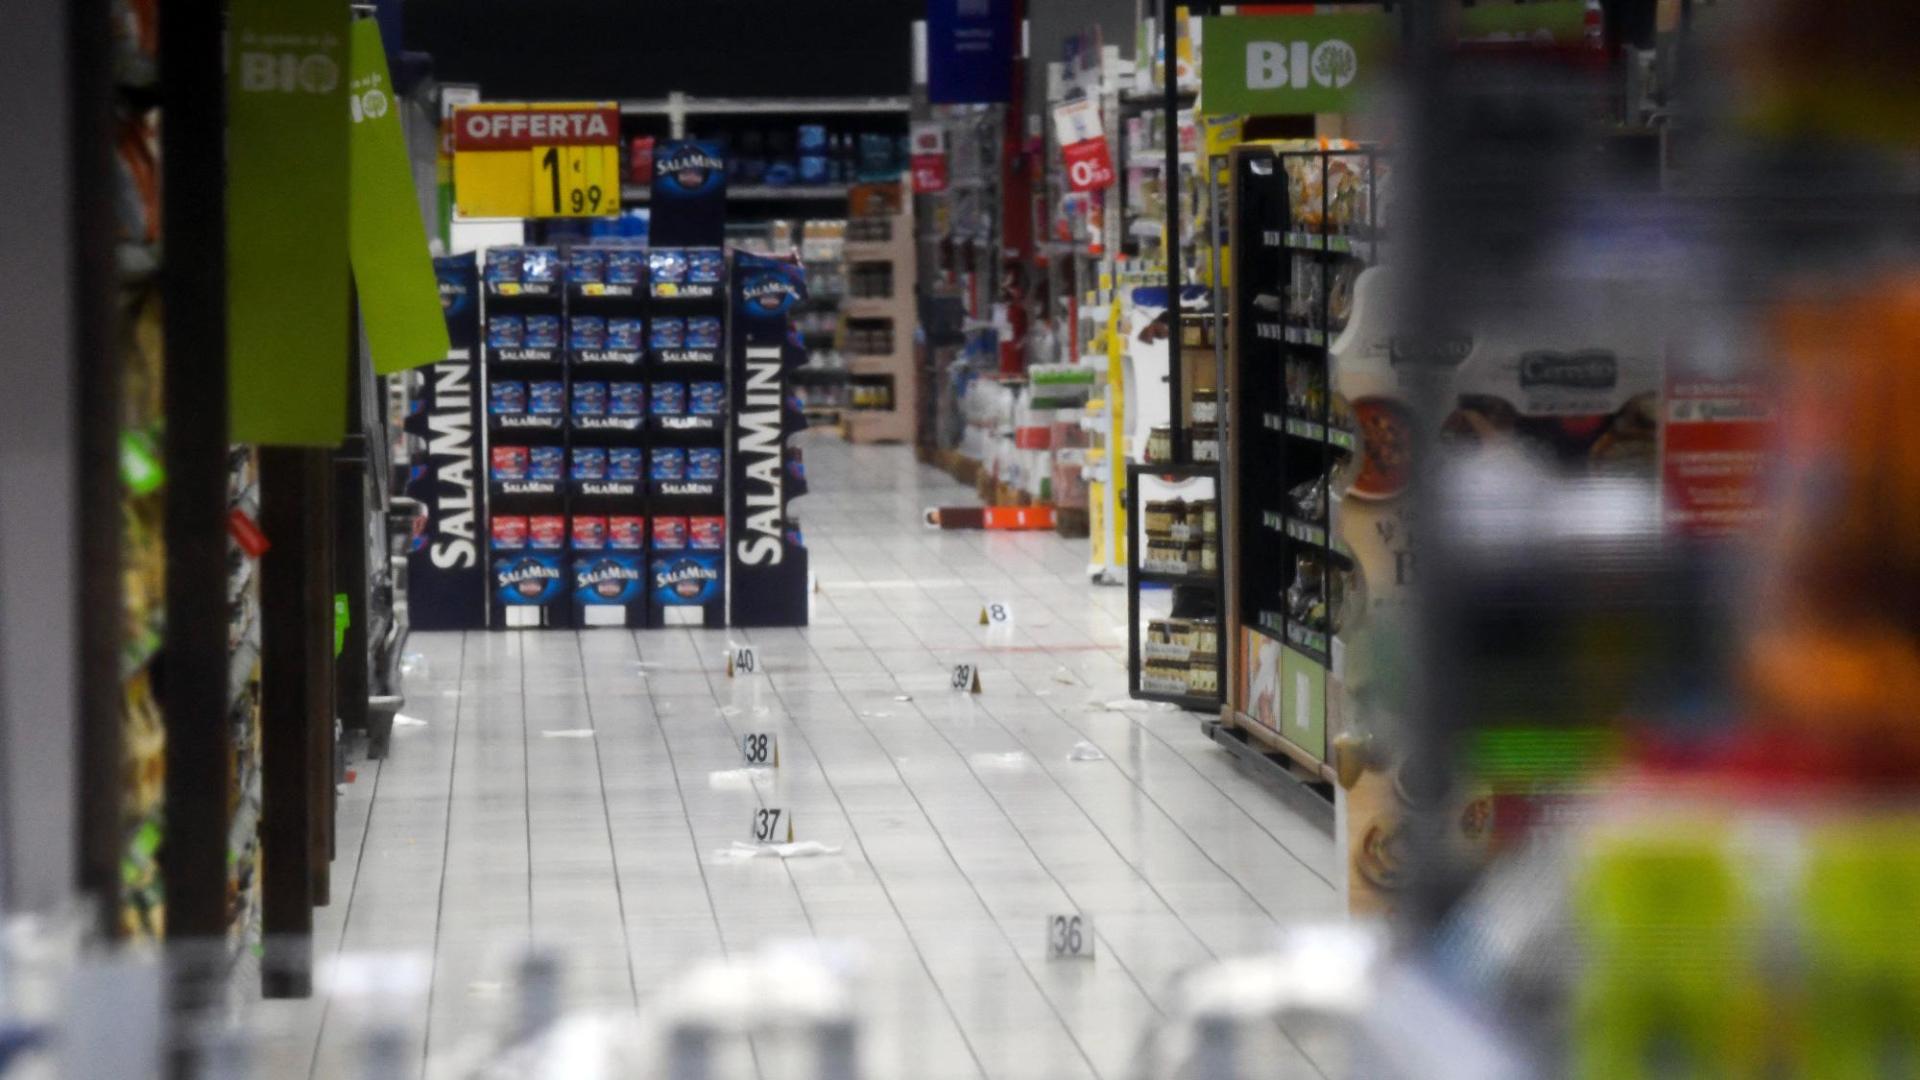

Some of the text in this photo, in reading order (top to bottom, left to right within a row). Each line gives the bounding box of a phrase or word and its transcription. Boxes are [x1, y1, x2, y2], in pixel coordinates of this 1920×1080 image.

[241, 52, 339, 94] BIO
[1246, 39, 1357, 89] BIO
[351, 89, 388, 123] IO
[466, 113, 608, 138] OFFERTA
[543, 148, 561, 214] 1
[570, 185, 602, 213] 99
[736, 649, 754, 673] 40
[952, 664, 970, 689] 39
[746, 734, 768, 763] 38
[757, 808, 781, 841] 37
[1054, 915, 1083, 955] 36
